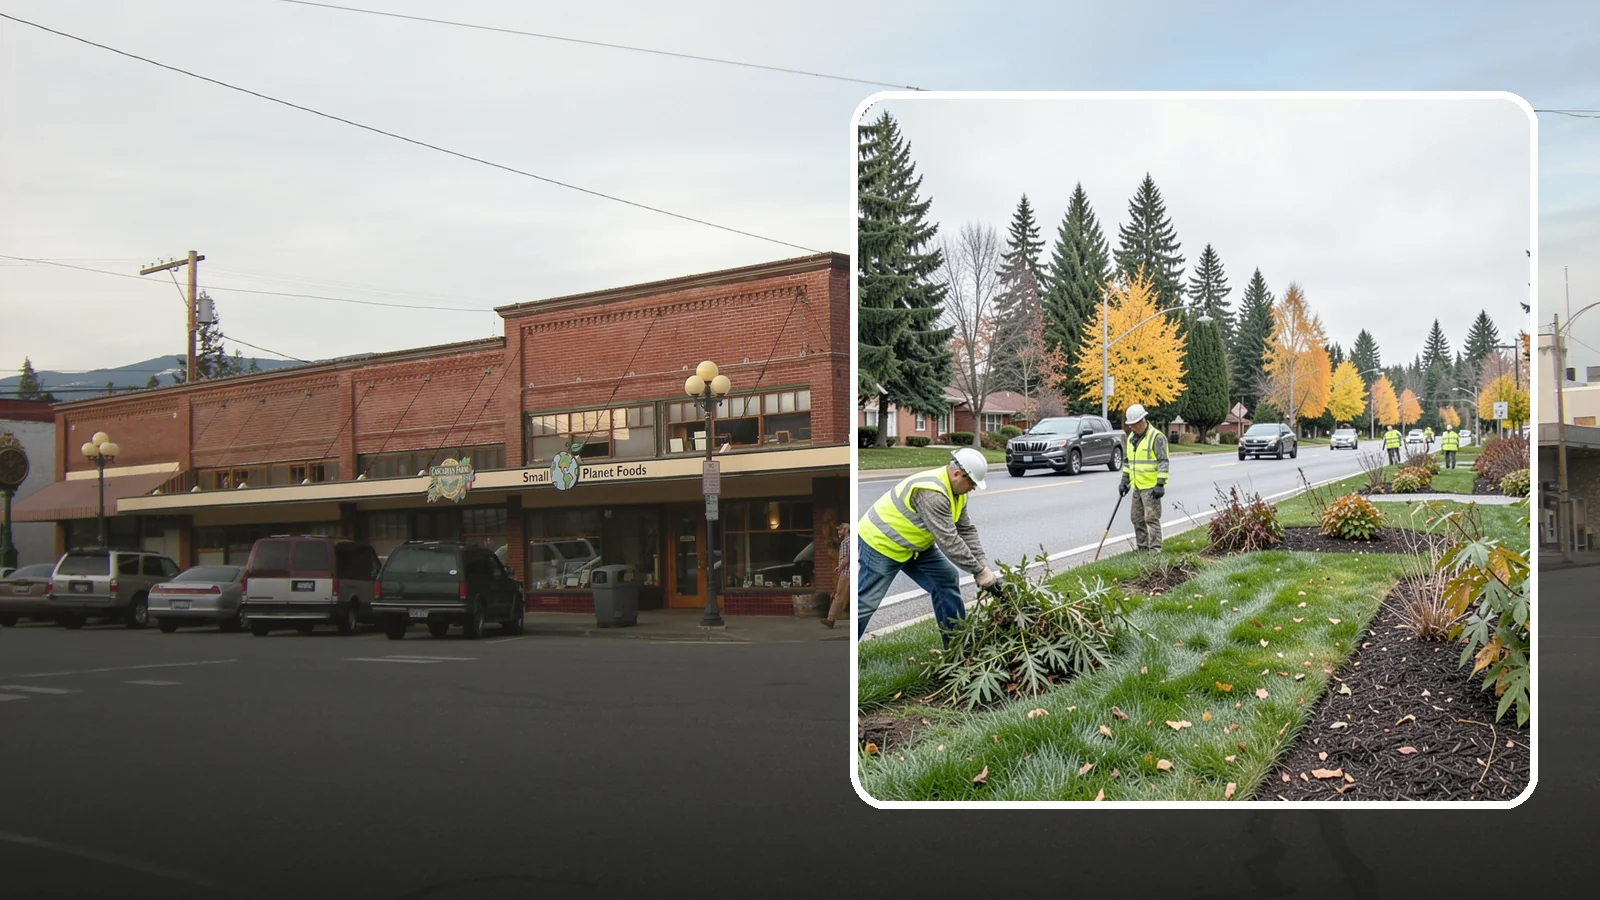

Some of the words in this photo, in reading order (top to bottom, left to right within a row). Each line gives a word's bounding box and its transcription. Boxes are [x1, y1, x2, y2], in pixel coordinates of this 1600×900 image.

[523, 471, 549, 483] Small
[583, 468, 613, 479] Planet
[617, 464, 647, 476] Foods
